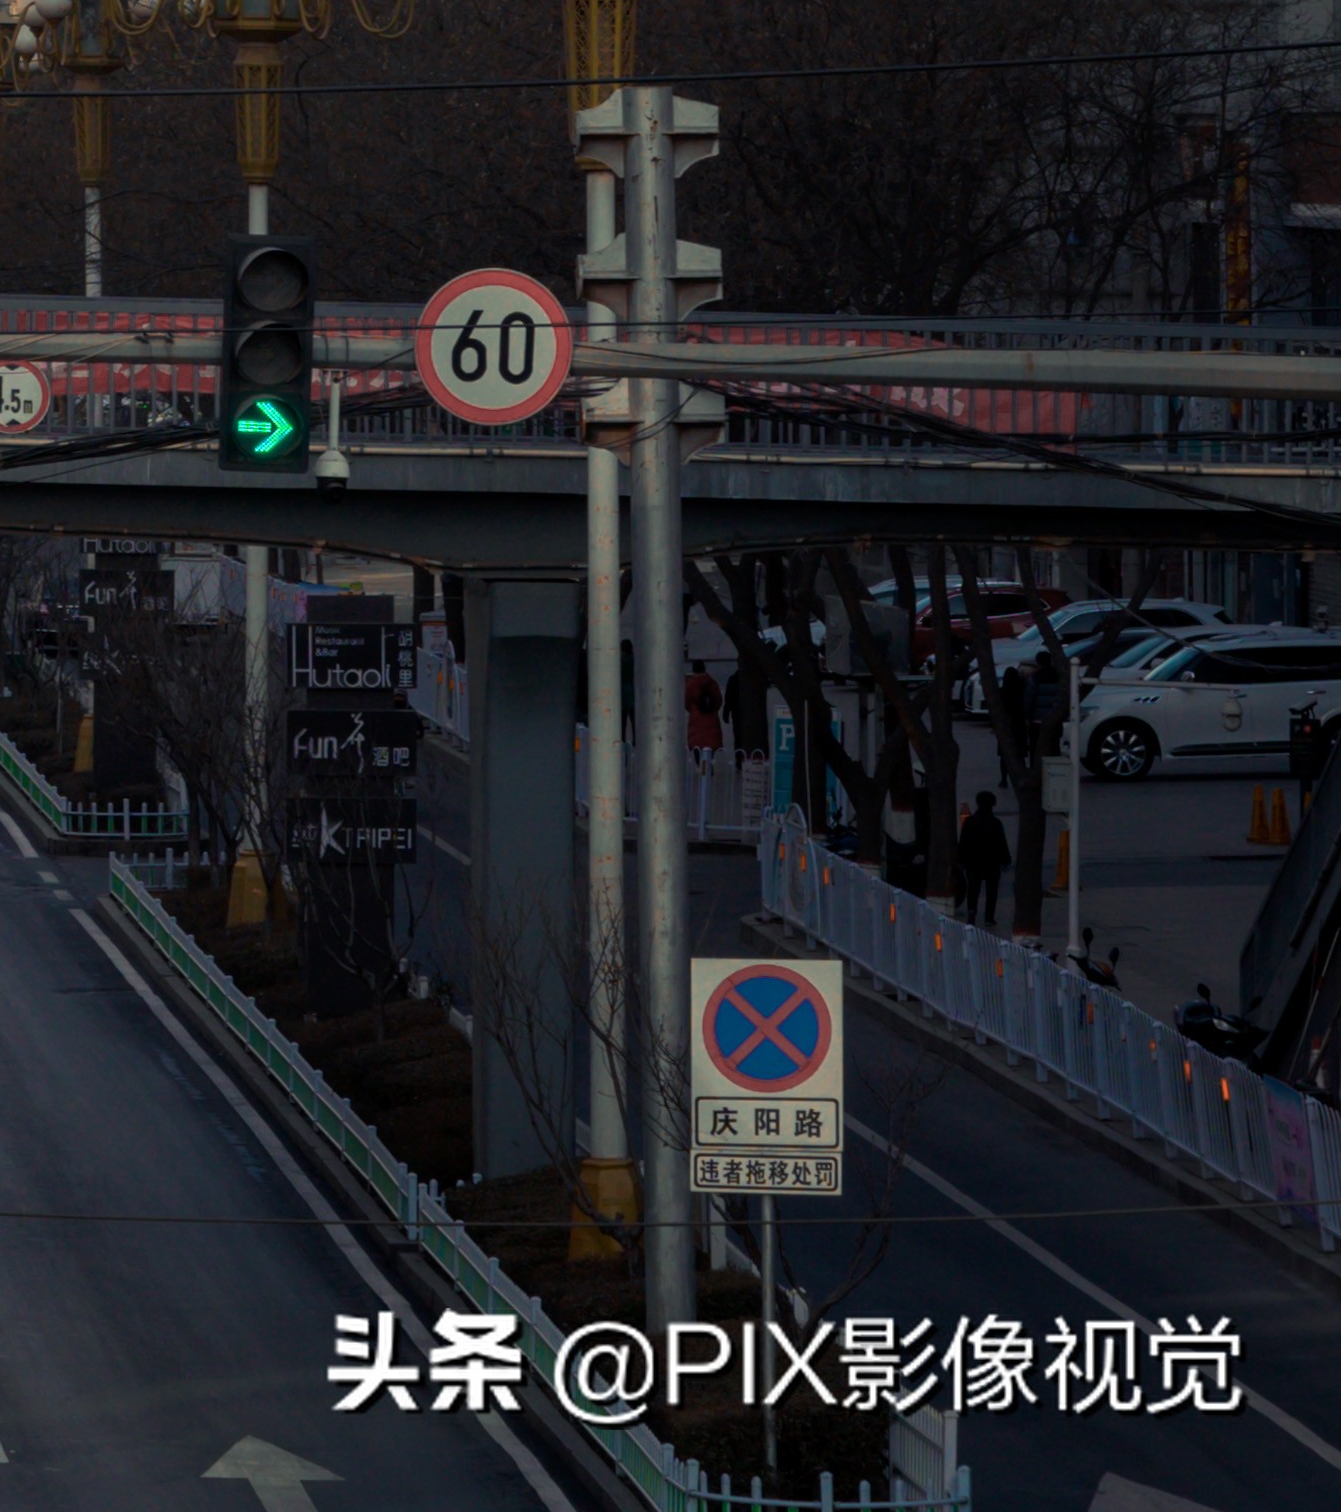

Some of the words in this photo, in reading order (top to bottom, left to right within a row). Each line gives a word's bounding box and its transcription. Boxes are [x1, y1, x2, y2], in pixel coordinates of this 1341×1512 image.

[452, 308, 536, 386] 60
[292, 625, 395, 688] Hutaoli
[710, 1106, 824, 1139] 庆阳路
[698, 1158, 833, 1187] 违者拖移处罚
